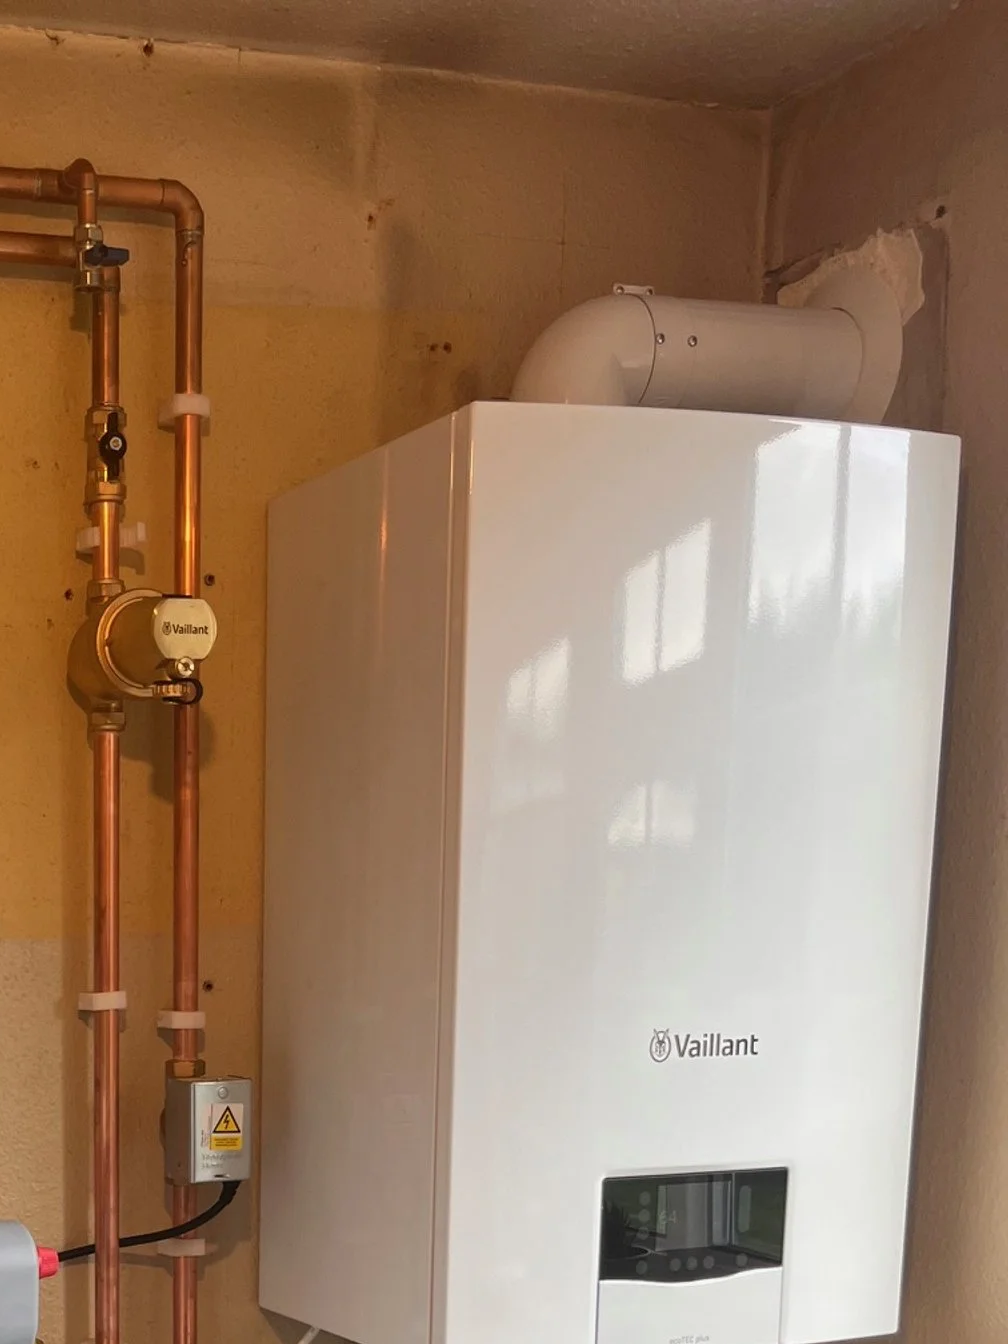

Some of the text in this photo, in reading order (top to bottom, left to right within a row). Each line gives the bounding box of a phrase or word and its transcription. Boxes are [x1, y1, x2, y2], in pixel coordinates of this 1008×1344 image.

[172, 623, 209, 635] Vaillant
[674, 1033, 759, 1058] Vaillant
[669, 1335, 709, 1344] ecoTEC plus
